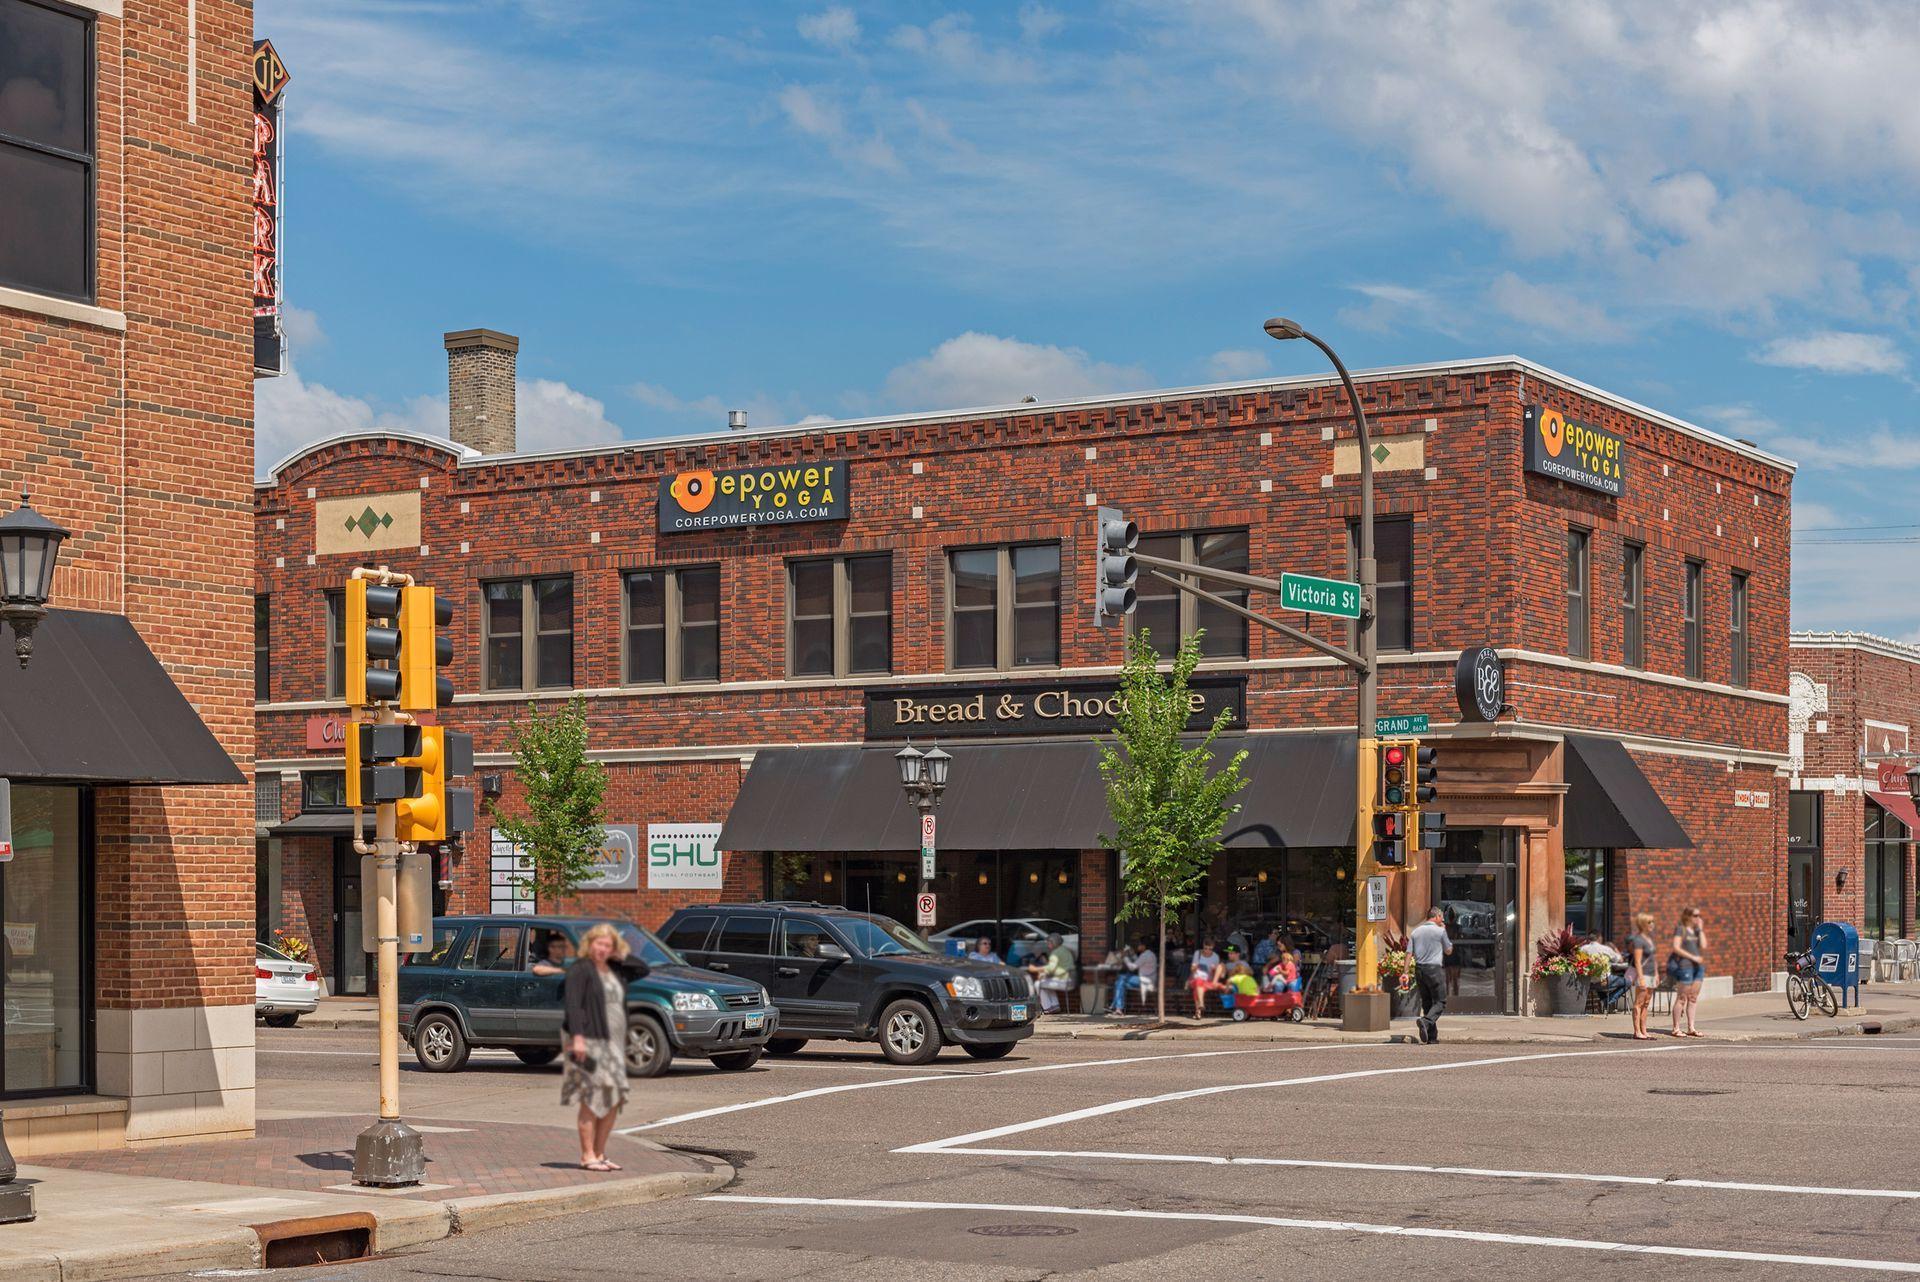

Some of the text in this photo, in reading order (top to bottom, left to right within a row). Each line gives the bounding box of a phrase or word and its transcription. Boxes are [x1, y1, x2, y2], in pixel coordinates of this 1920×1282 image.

[253, 113, 276, 298] PARK
[1542, 460, 1619, 492] COREPOWERYOGA.COM
[1582, 452, 1620, 479] YOGA
[752, 488, 834, 509] YOGA
[675, 507, 828, 528] COREPOWERYOGA.COM
[1288, 582, 1355, 609] Victoria St
[893, 689, 1206, 725] Bread & Choce
[1377, 719, 1409, 732] GRAND
[650, 843, 718, 866] SHU
